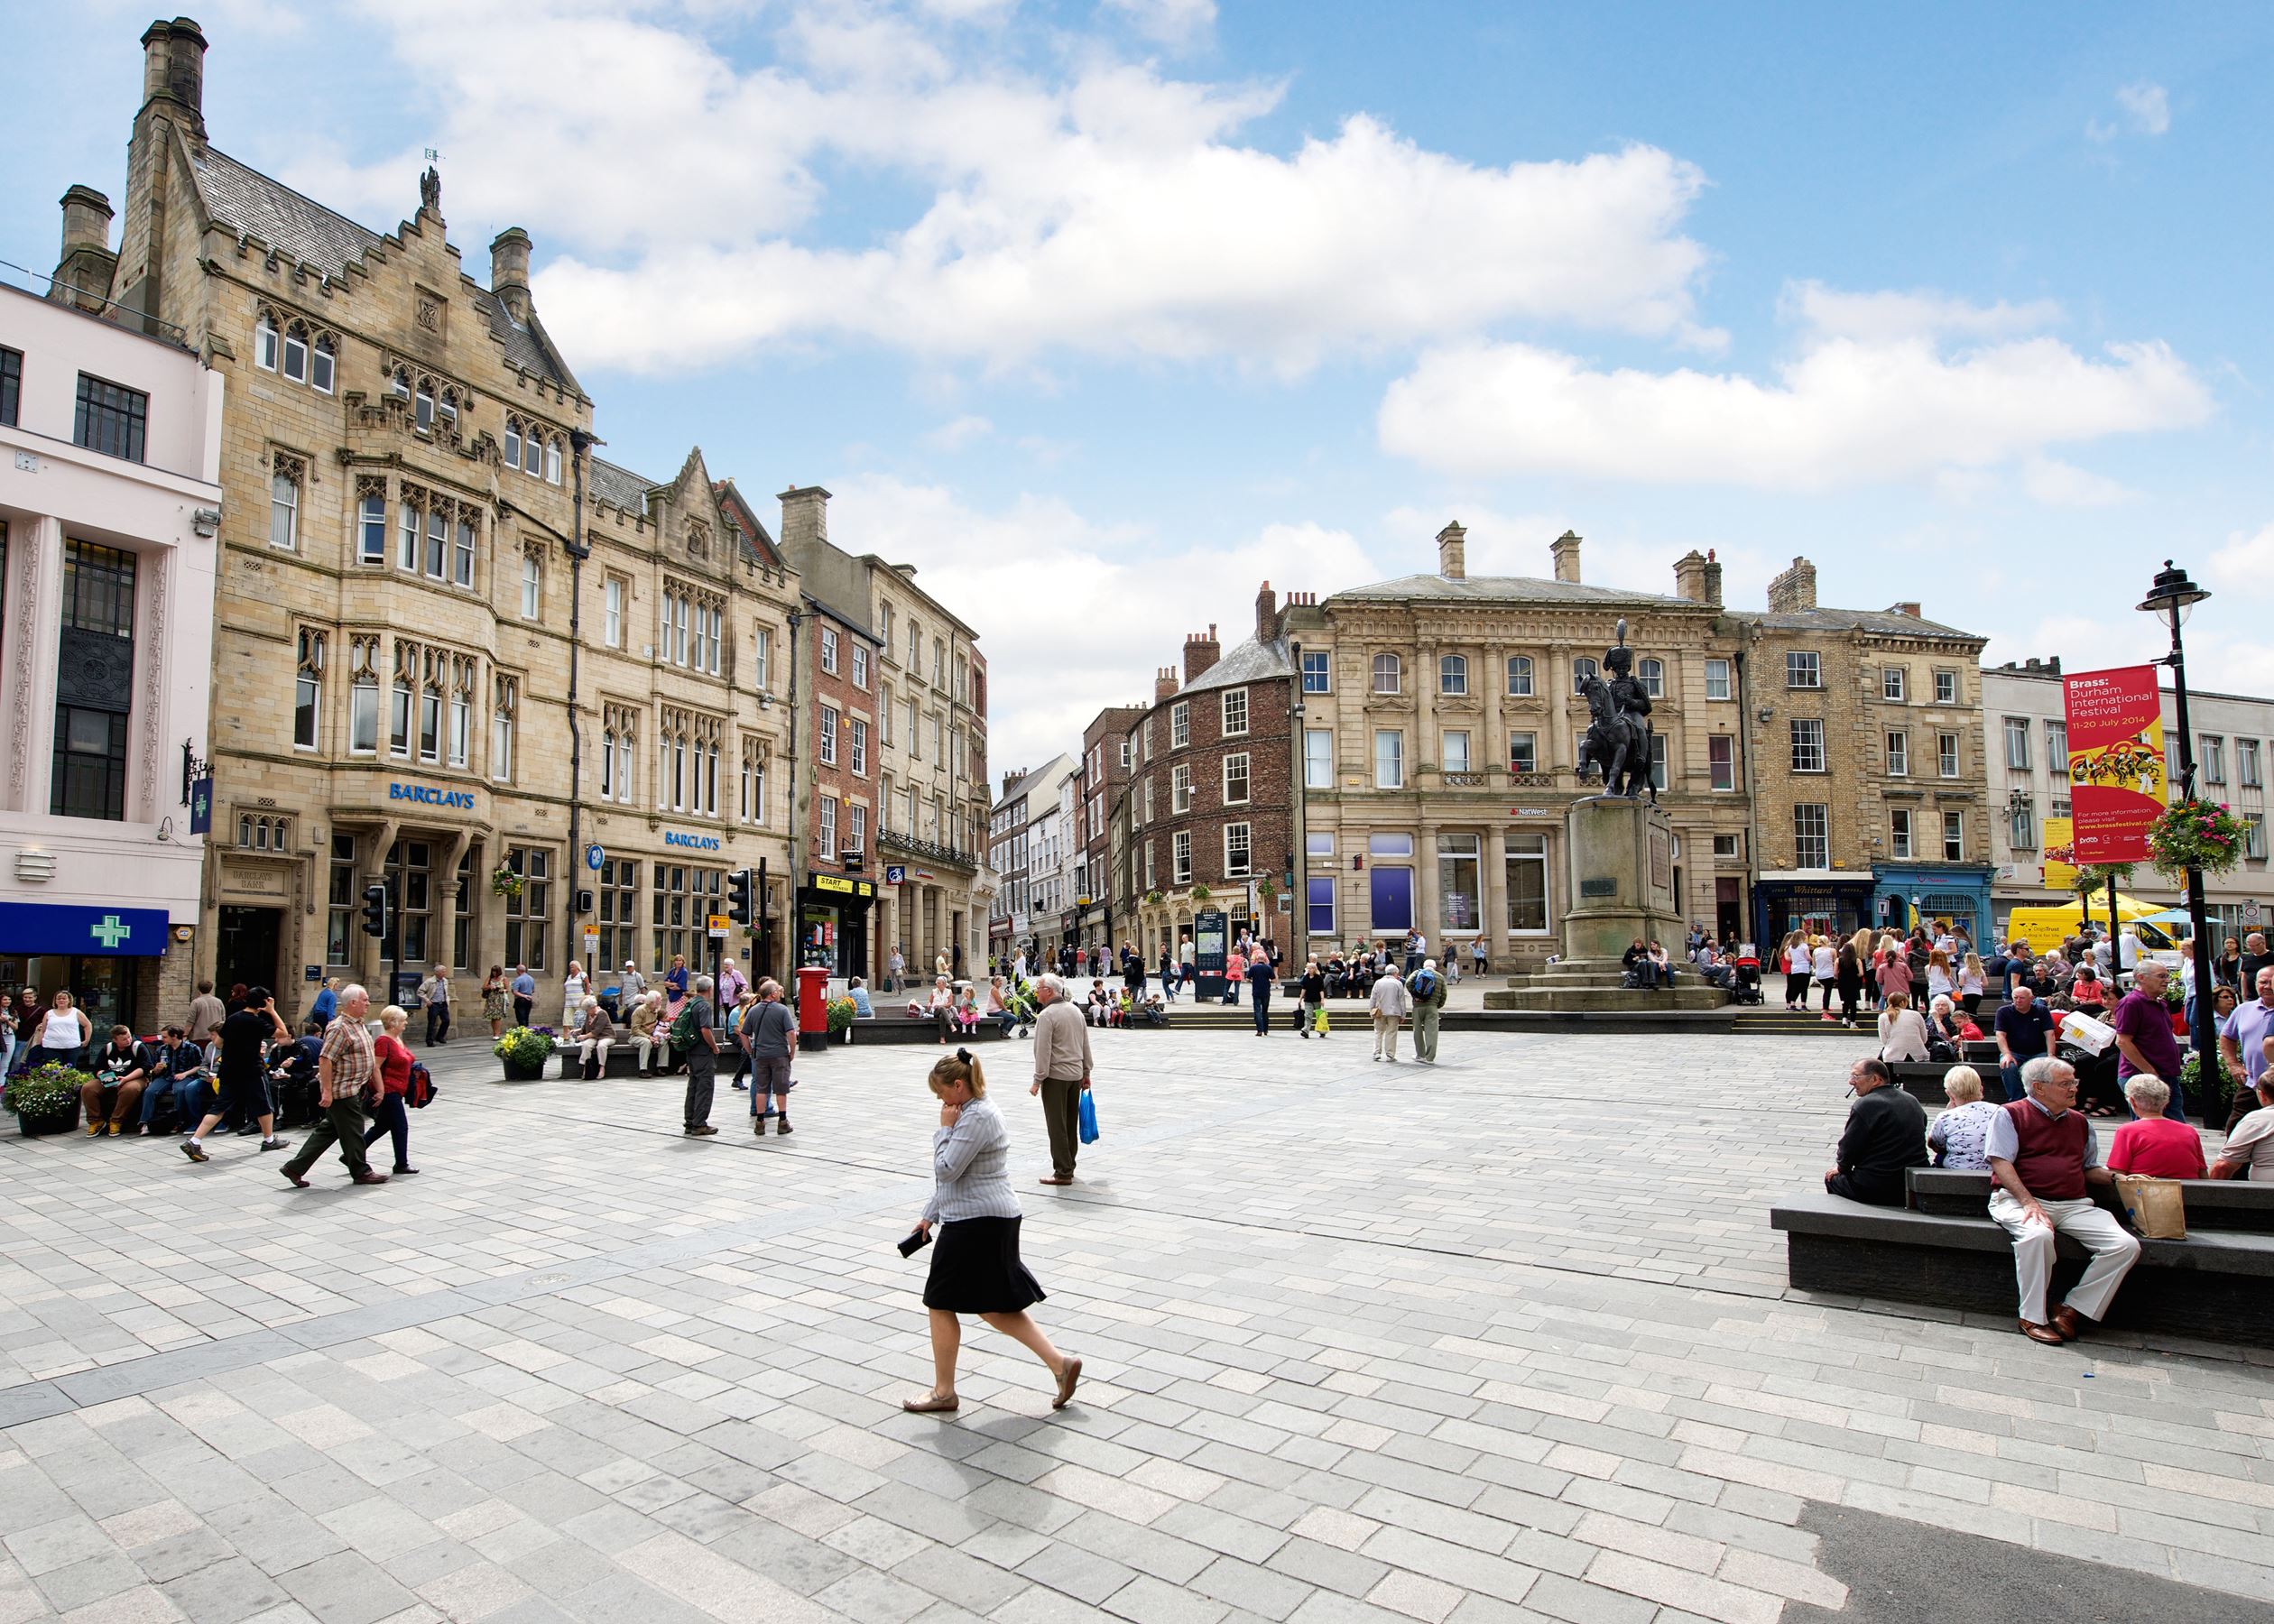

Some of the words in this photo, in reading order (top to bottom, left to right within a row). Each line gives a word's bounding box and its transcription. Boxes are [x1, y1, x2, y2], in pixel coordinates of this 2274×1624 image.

[2069, 678, 2109, 689] Brass:
[2071, 687, 2121, 699] Durham
[2071, 692, 2152, 708] International
[2072, 705, 2121, 717] Festival
[2072, 721, 2096, 729] 11-20
[2099, 719, 2119, 727] July
[2121, 716, 2145, 724] 2014
[390, 782, 475, 809] BARCLAYS
[2078, 820, 2153, 830] www.brassfestival.co
[665, 831, 719, 851] BARCLAYS
[233, 871, 273, 881] BARCLAYS
[241, 881, 265, 890] BANK
[821, 878, 842, 887] START
[1793, 885, 1834, 894] Whittard
